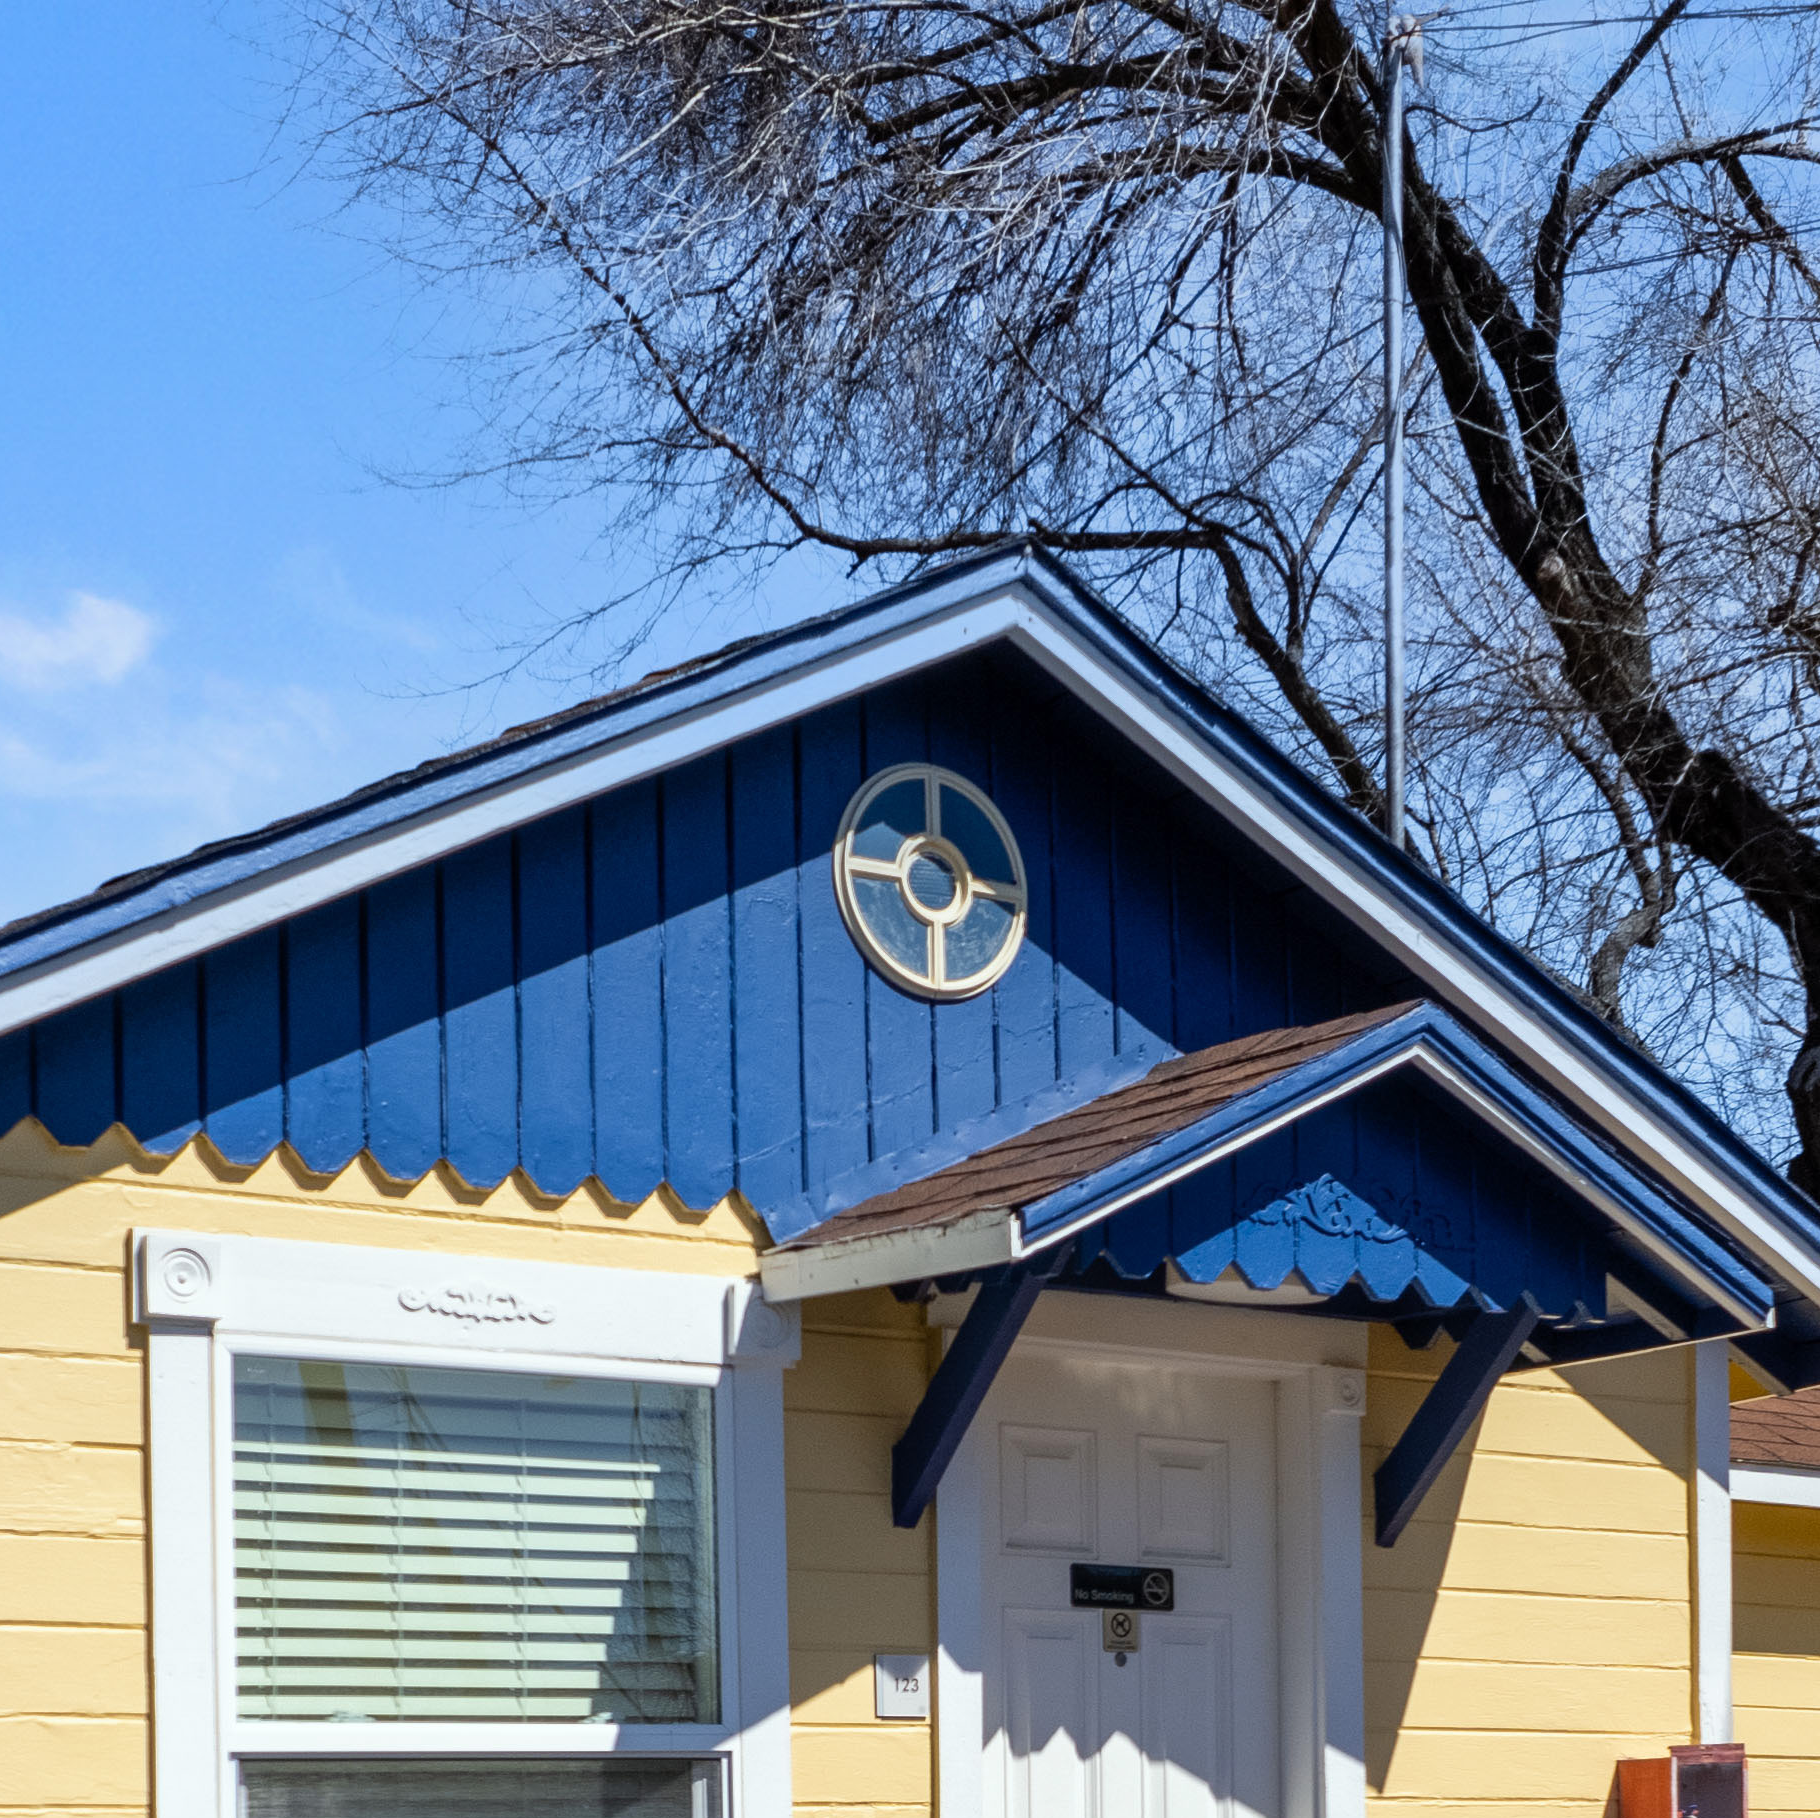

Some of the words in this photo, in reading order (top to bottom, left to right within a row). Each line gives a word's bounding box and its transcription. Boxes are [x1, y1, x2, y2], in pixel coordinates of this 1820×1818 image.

[1074, 1589, 1089, 1600] No
[1091, 1589, 1134, 1604] Smoking
[894, 1678, 919, 1692] 123
